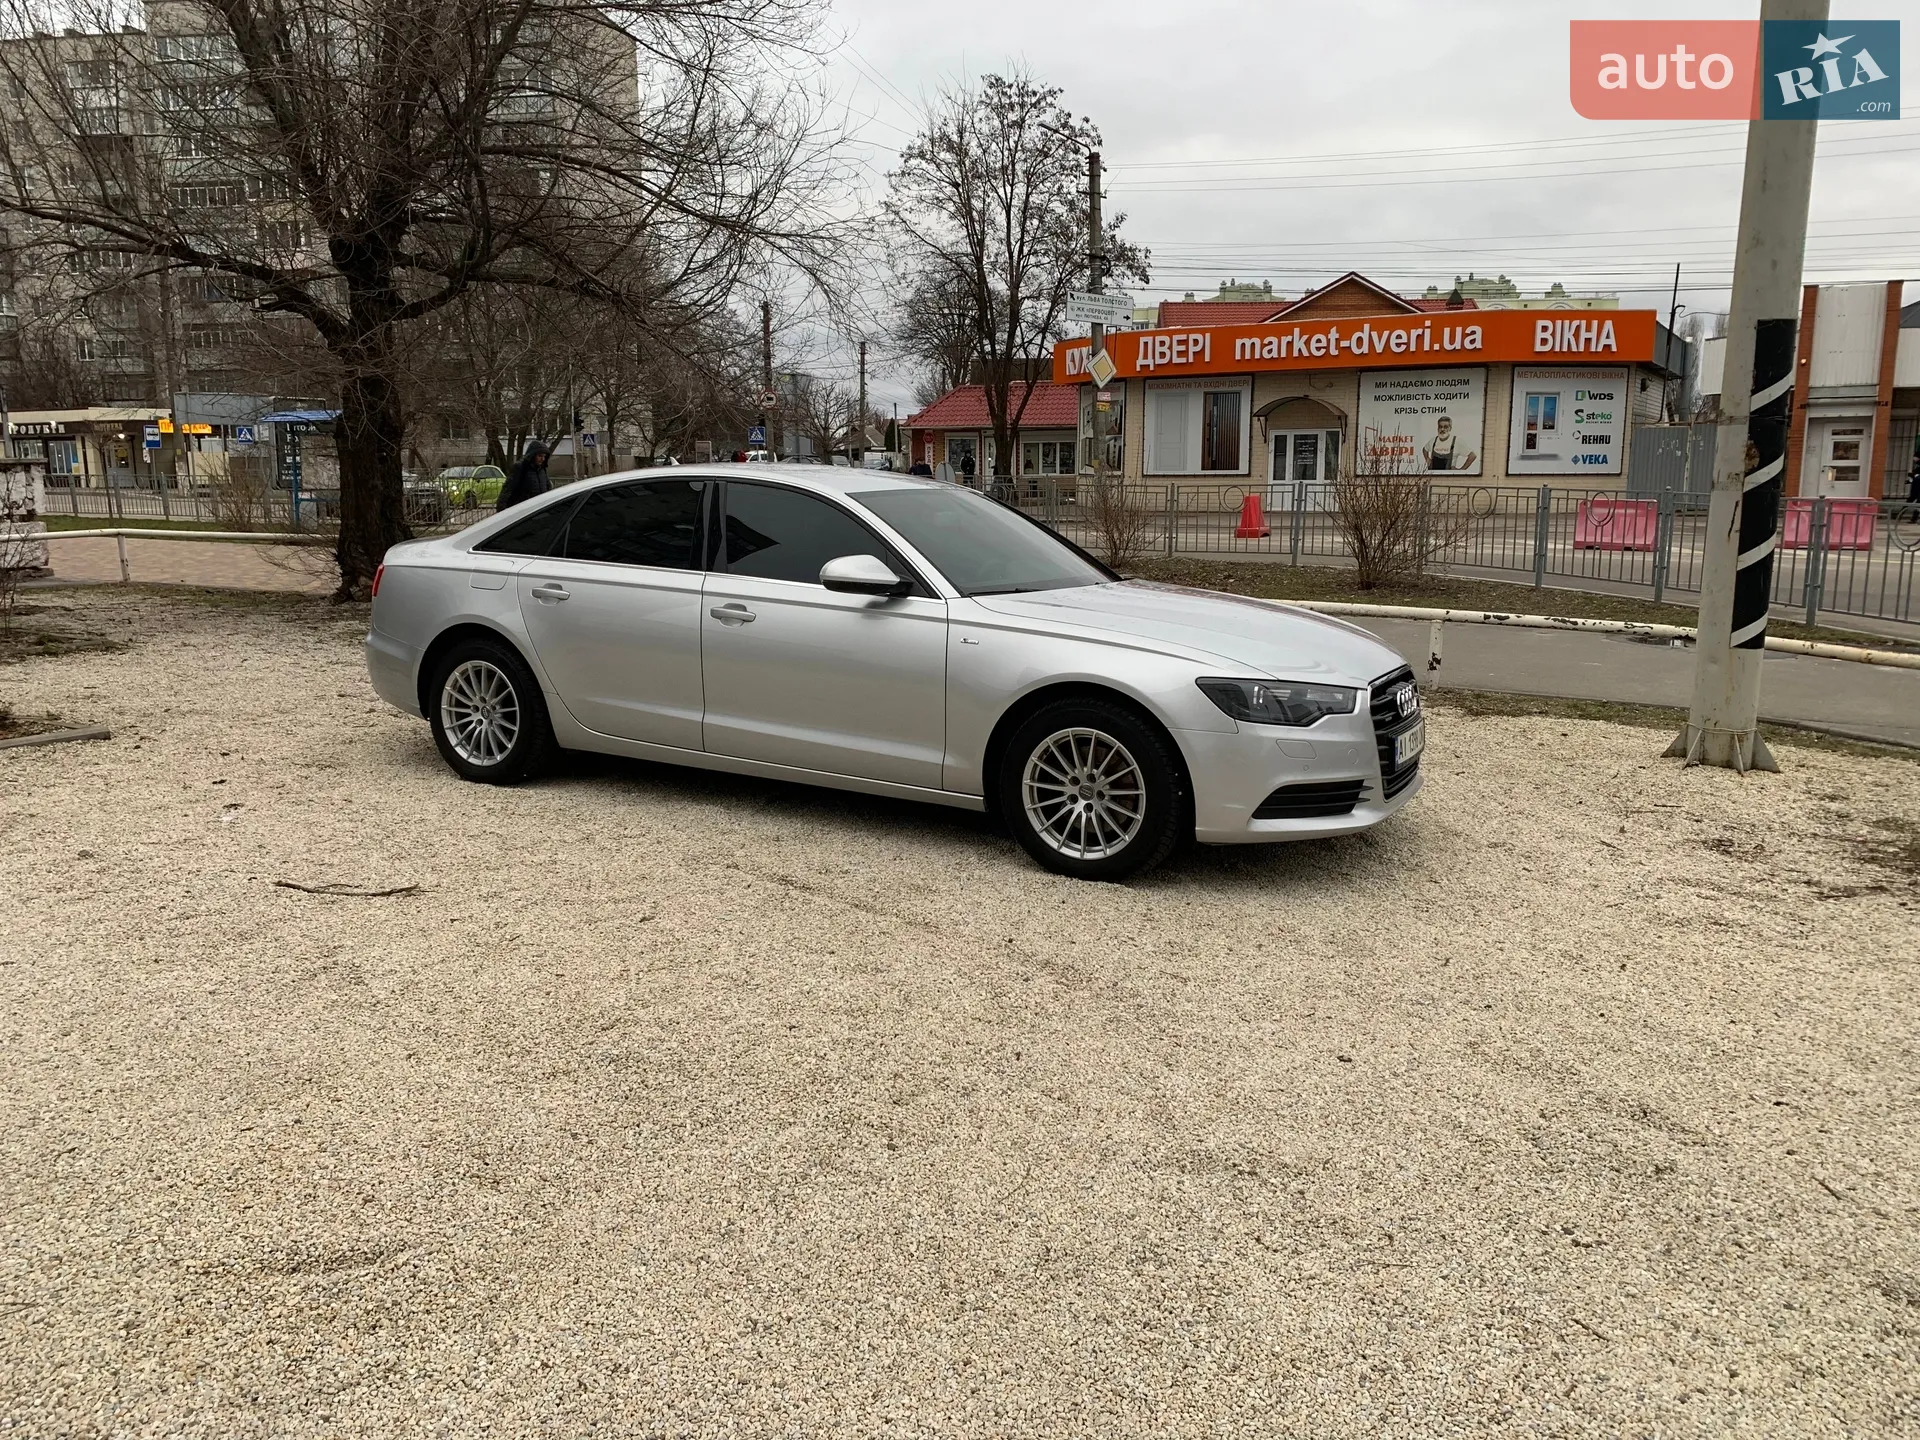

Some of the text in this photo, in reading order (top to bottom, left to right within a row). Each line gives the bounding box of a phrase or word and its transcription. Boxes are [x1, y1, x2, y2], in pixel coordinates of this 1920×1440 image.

[1101, 297, 1128, 307] ТОЛСТОГО
[1065, 319, 1618, 376] КУХ ДВЕРІ market-dveri.ua ВІКНА
[1516, 370, 1625, 380] МЕТАЛОПЛАСТИКОВІ ВІКНА
[1147, 379, 1250, 390] МІЖКІМНАТНІ ТА ВХІДНІ ДВЕРІ
[1374, 378, 1470, 389] МИ НАДАЄМО ЛЮДЯМ
[1373, 392, 1470, 402] МОЖЛИВІСТЬ ХОДИТИ
[1587, 390, 1614, 401] WDS
[1394, 406, 1447, 415] КРІЗЬ СТІНИ
[1585, 411, 1613, 421] steko
[1581, 434, 1612, 445] REHAU
[1581, 454, 1609, 465] VEKA
